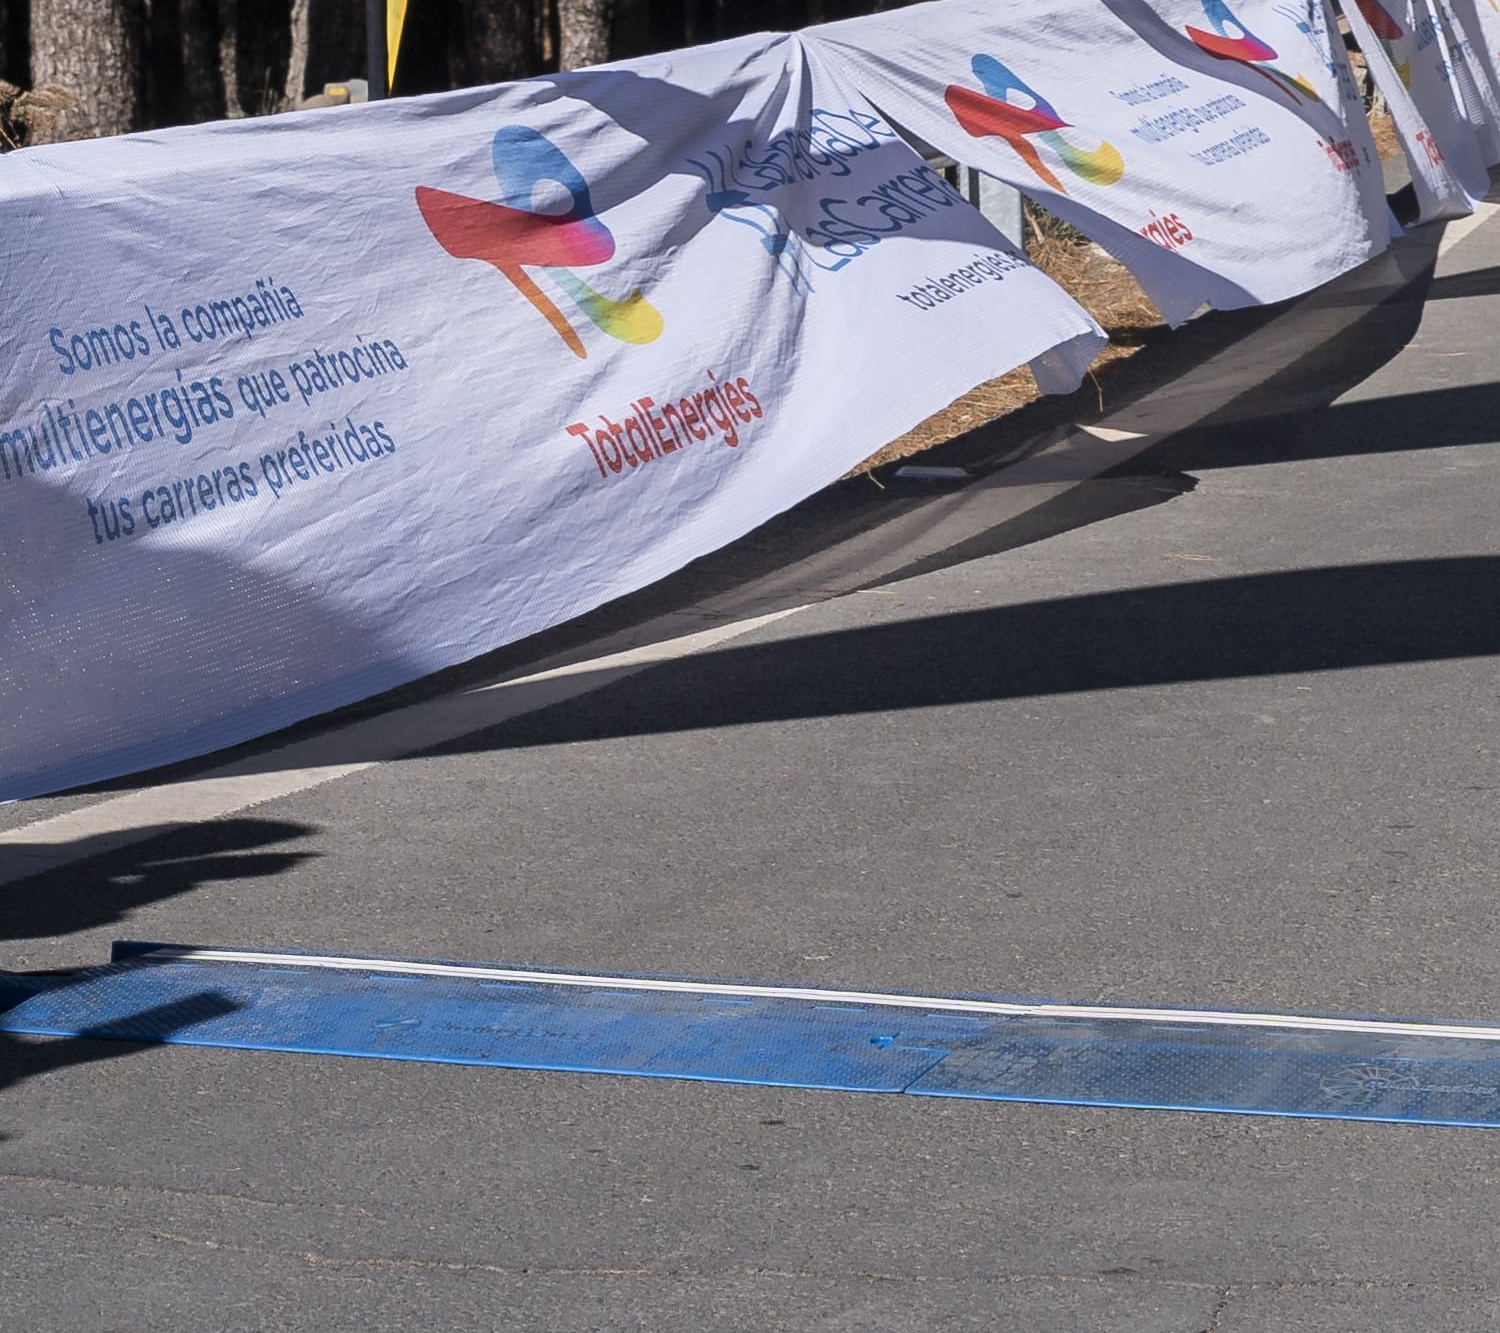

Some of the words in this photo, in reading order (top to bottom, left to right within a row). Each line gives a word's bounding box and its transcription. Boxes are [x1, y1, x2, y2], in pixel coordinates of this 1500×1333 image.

[49, 319, 149, 376] Somos
[153, 303, 180, 345] la
[186, 276, 305, 345] compañía
[237, 367, 290, 417] que
[292, 333, 409, 401] patrocina
[565, 369, 766, 480] TotalEnergies
[87, 495, 135, 546] tus
[142, 459, 260, 531] carreras
[260, 414, 397, 497] preferidas
